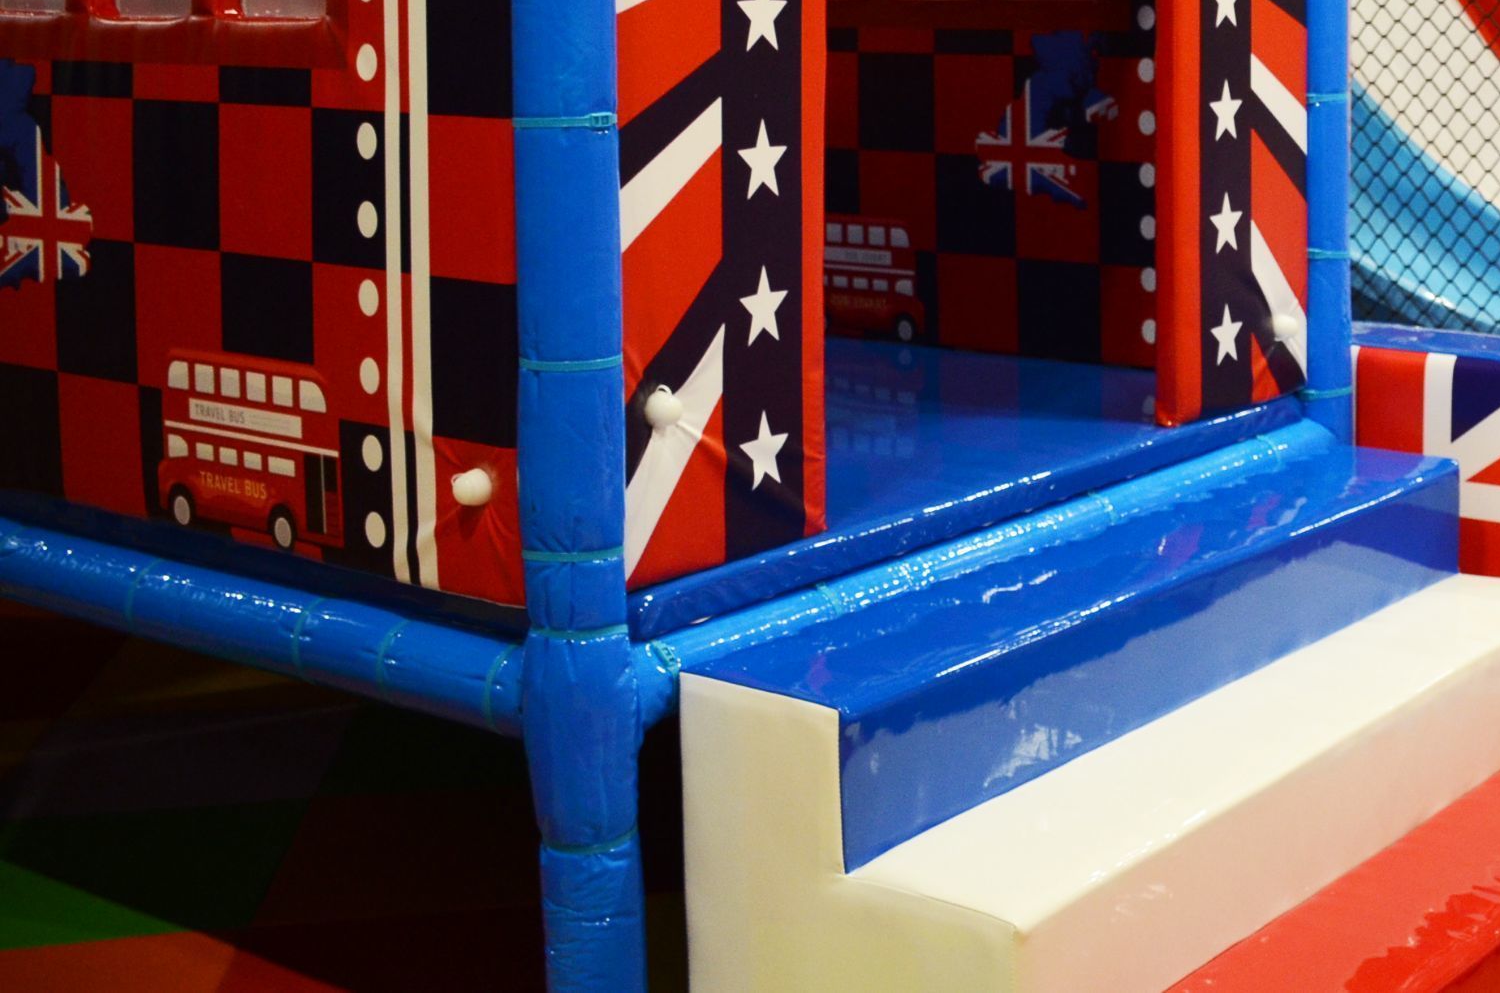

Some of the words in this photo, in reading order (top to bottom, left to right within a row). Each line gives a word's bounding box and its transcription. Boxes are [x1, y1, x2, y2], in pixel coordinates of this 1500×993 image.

[194, 403, 225, 422] TRAVEL
[228, 409, 246, 424] BUS
[199, 470, 241, 494] TRAVEL
[243, 479, 267, 500] BUS
